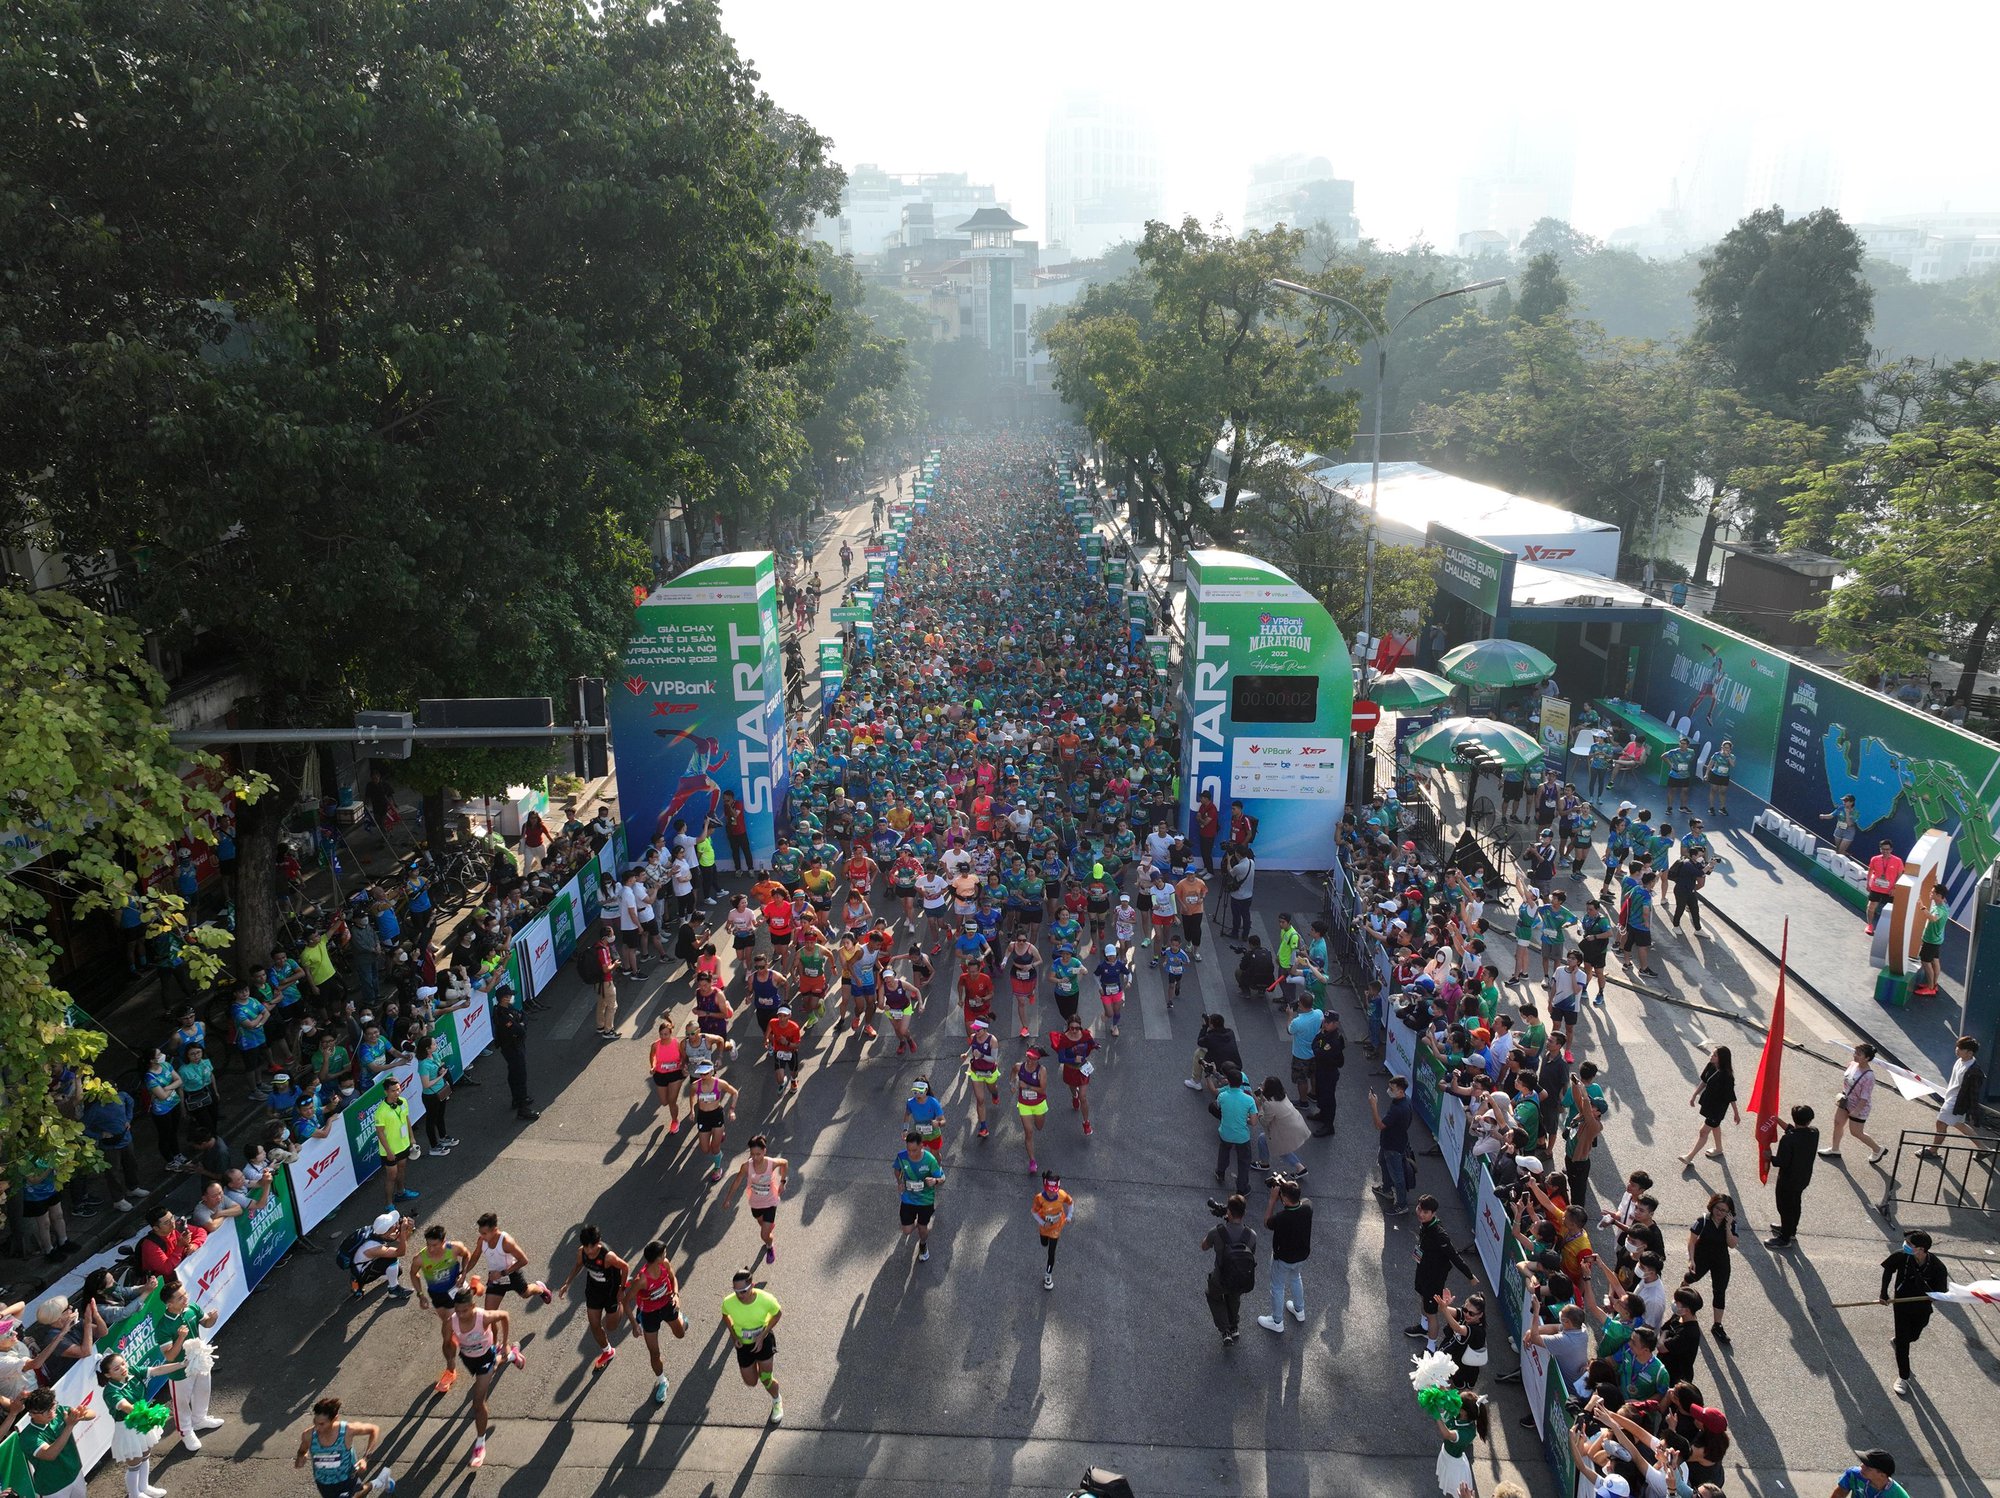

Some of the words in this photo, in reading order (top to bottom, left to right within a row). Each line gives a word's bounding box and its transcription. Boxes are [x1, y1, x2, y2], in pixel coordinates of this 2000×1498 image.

[1520, 545, 1577, 562] XTEP
[1446, 547, 1477, 571] CALORIES
[1477, 560, 1498, 581] BURN
[1444, 561, 1482, 589] CHALLENGE
[682, 624, 714, 634] CHẠY
[1271, 617, 1304, 625] VPBank
[1260, 624, 1303, 636] HANOI
[677, 635, 688, 643] DI
[1249, 635, 1312, 653] MARATHON
[627, 646, 674, 655] VPBANK
[688, 656, 718, 664] 2022
[1453, 668, 1474, 680] VPBank
[1514, 671, 1538, 680] VPBank
[1756, 663, 1778, 678] VPBank
[651, 679, 716, 695] VPBank
[1241, 692, 1311, 706] 00:00:02
[648, 701, 700, 718] XTEP
[1189, 621, 1230, 812] START
[728, 622, 774, 814] START
[1790, 721, 1811, 737] 42KM
[1262, 747, 1294, 755] VPBank
[1298, 747, 1328, 755] XTEP
[1788, 746, 1805, 761] 10KM
[460, 1004, 484, 1036] XTEP
[1396, 1041, 1412, 1068] VPBank
[304, 1145, 341, 1191] XTEP
[250, 1197, 277, 1231] HANOI
[1482, 1201, 1500, 1242] XTEP
[246, 1202, 284, 1256] MARATHON
[195, 1249, 231, 1303] XTEP
[120, 1320, 155, 1360] HANOI
